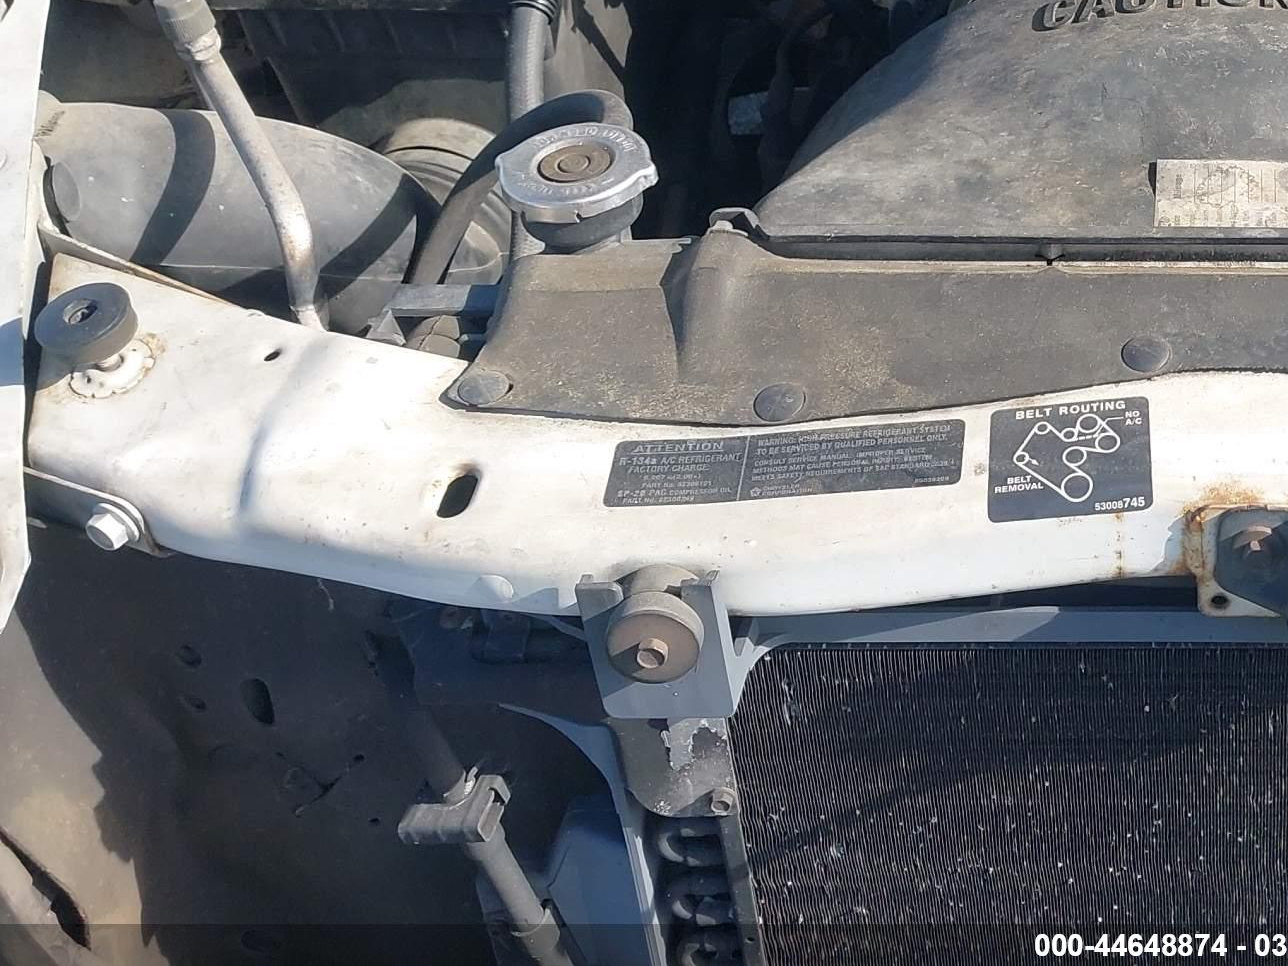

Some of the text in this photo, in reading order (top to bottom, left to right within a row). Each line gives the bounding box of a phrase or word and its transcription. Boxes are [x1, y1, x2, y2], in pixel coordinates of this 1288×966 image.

[1015, 400, 1126, 420] BELT ROUTING
[633, 442, 724, 452] ATTENTION
[781, 444, 820, 453] SERVICED
[822, 442, 833, 450] BY
[835, 439, 877, 449] QUALIFIED
[878, 436, 925, 445] PERSONNEL
[619, 453, 743, 466] R-134a A/C REFRIGERANT
[628, 465, 670, 473] FACTORY
[1007, 475, 1031, 484] BELT
[995, 482, 1044, 494] REMOVAL
[1094, 497, 1145, 511] 53008745
